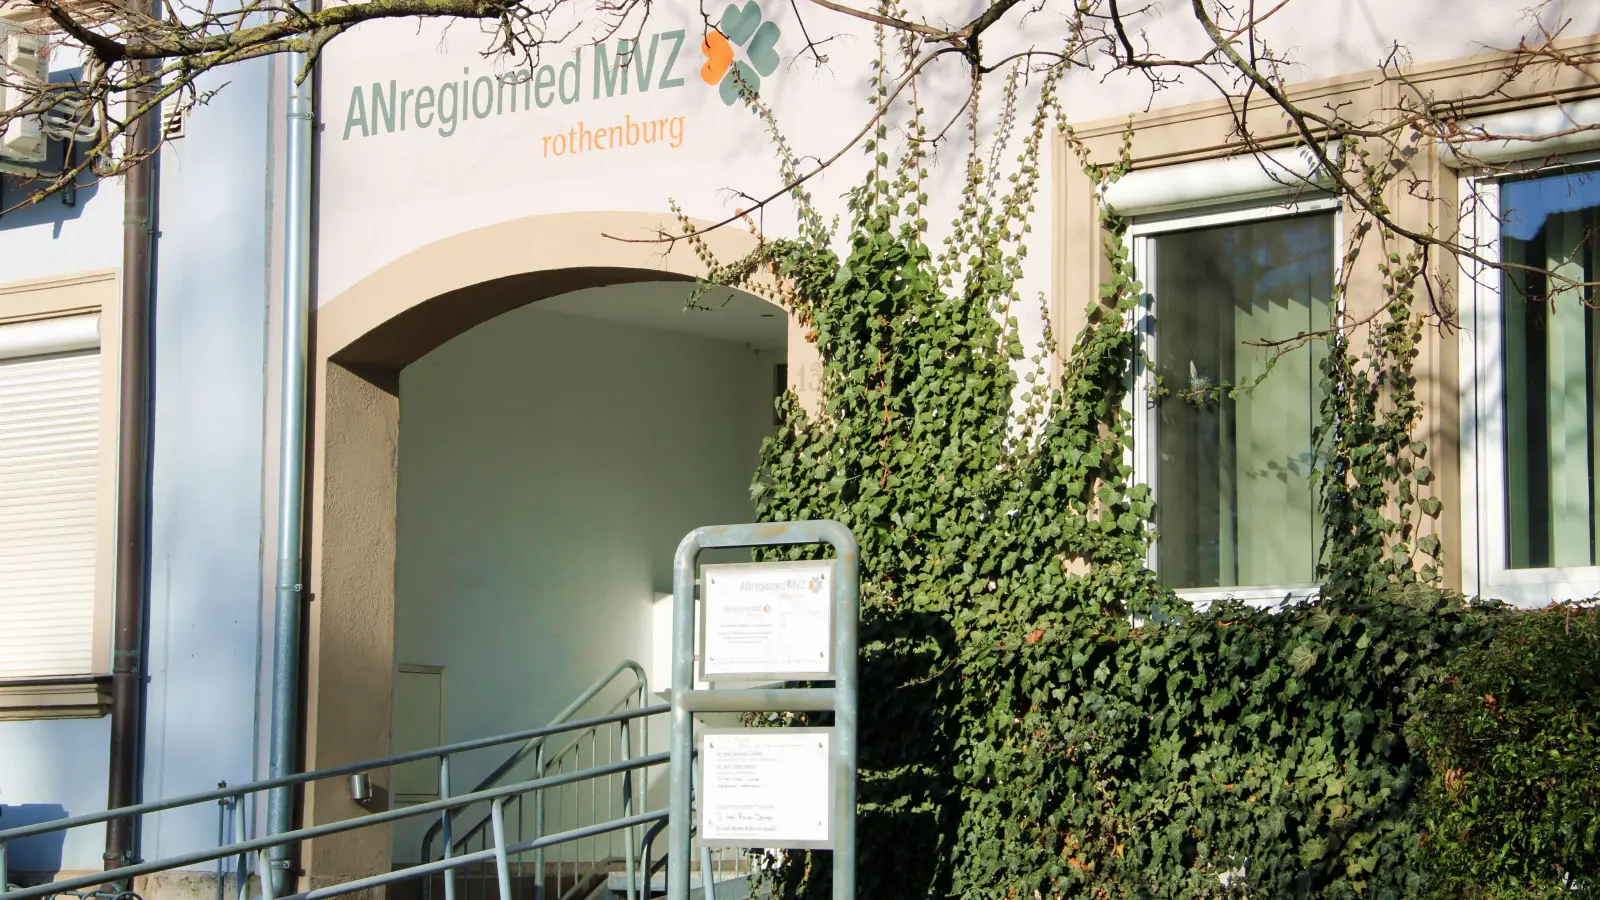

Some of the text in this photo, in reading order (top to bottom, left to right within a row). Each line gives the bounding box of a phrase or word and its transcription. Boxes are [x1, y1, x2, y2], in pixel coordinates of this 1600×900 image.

[342, 29, 686, 140] ANregiomed MVZ
[542, 112, 686, 158] rothenburg
[739, 579, 806, 593] ANregiomed MVZ
